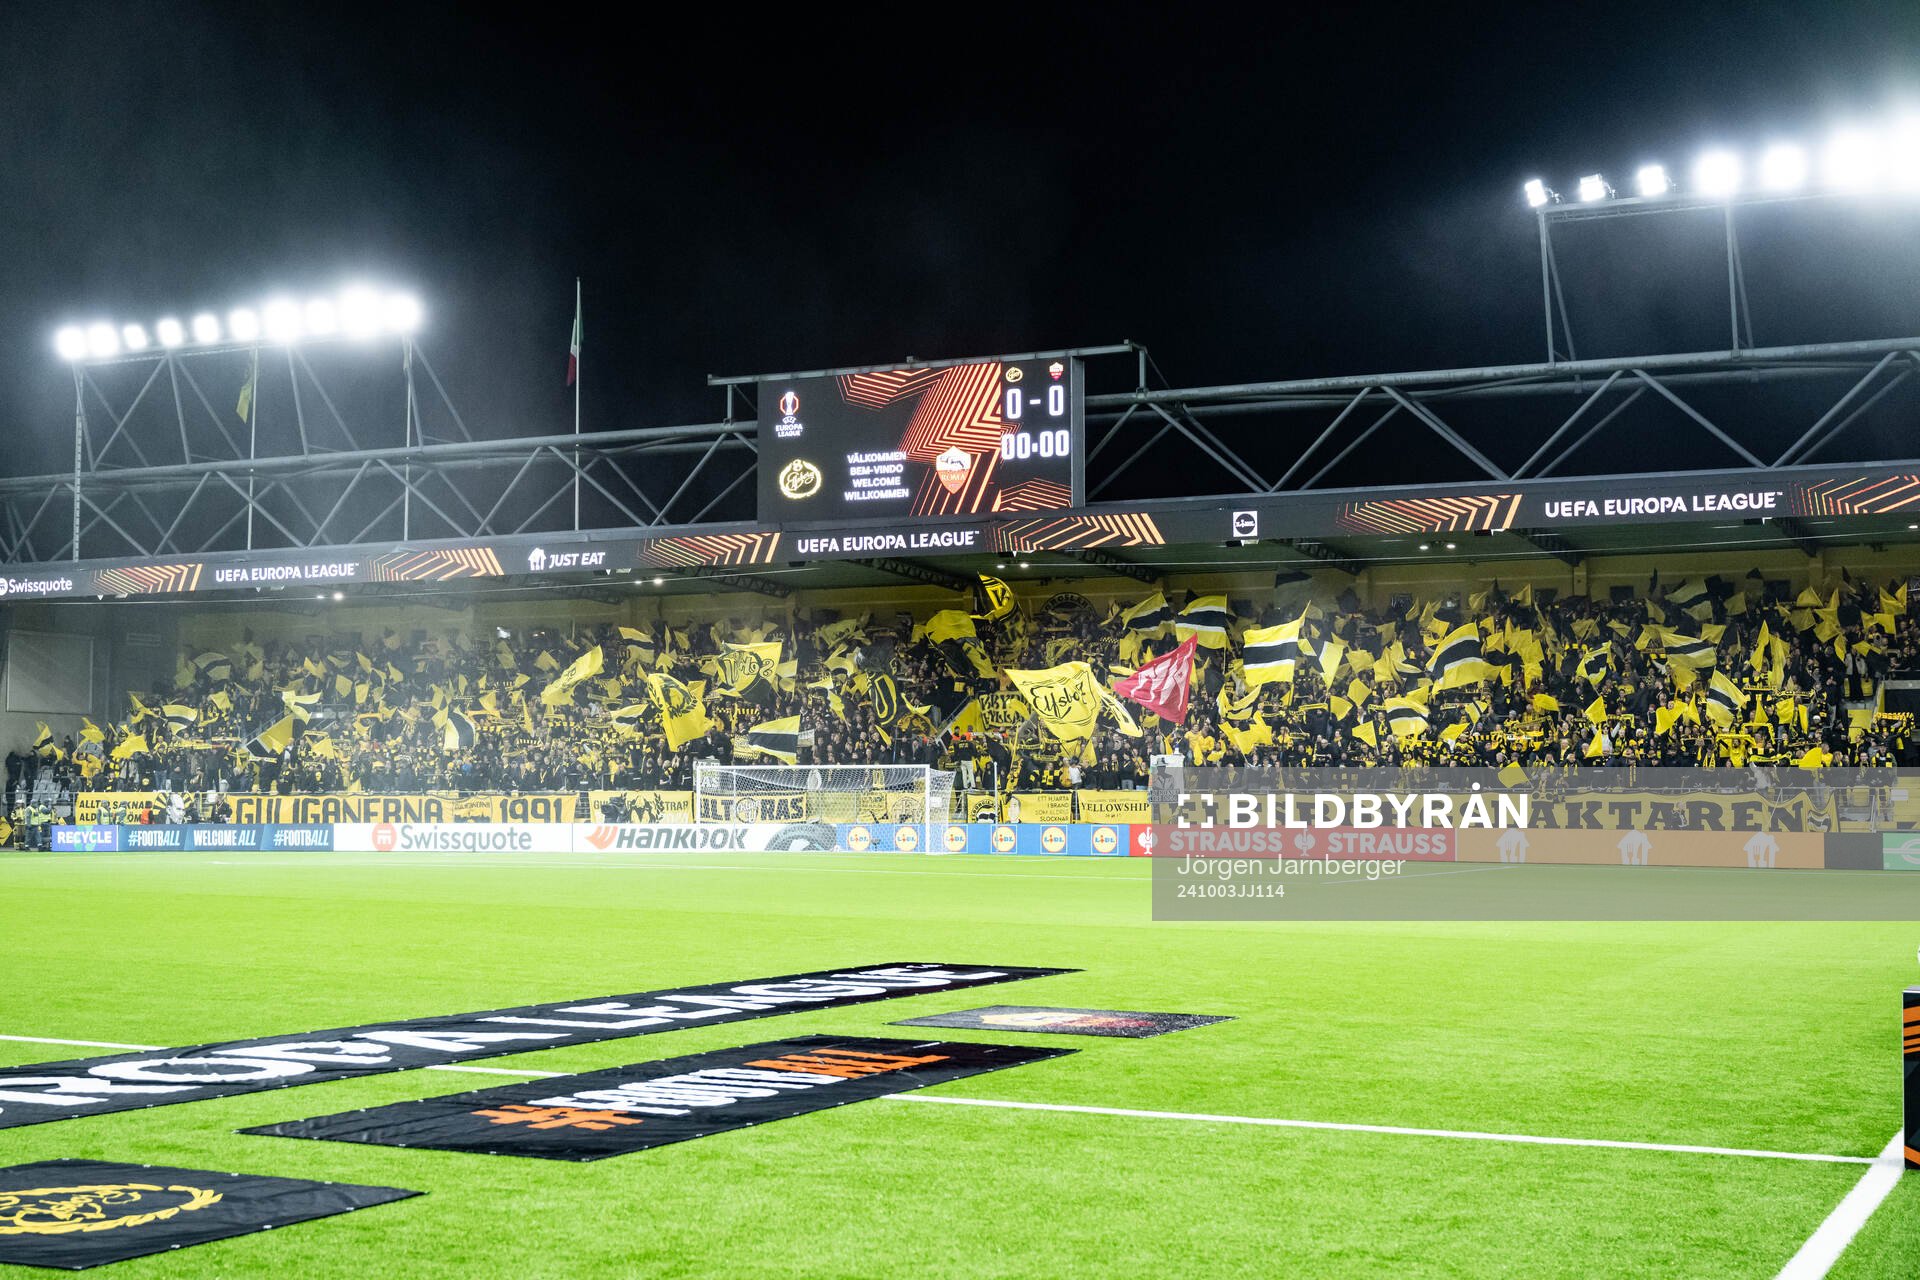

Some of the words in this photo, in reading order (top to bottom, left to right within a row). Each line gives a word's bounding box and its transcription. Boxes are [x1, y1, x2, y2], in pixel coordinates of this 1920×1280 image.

[1006, 388, 1022, 419] 0
[1048, 385, 1064, 416] 0
[775, 423, 803, 432] EUROPA
[777, 430, 801, 438] LEAGUE
[847, 451, 907, 464] VÄLKOMMEN
[850, 463, 904, 476] BEM-VINDO
[940, 473, 966, 481] ROMA
[852, 476, 902, 488] WELCOME
[844, 488, 909, 501] WILLKOMMEN
[1545, 500, 1600, 518] UEFA
[1604, 496, 1688, 515] EUROPA
[1692, 492, 1777, 512] LEAGUE
[797, 538, 840, 554] UEFA
[843, 534, 907, 551] EUROPA
[910, 530, 974, 548] LEAGUE
[548, 553, 579, 569] JUST
[581, 552, 605, 566] EAT
[215, 568, 249, 582] UEFA
[251, 566, 302, 580] EUROPA
[304, 562, 355, 579] LEAGUE
[8, 577, 73, 596] Swissquote
[499, 798, 563, 824] 1991
[1080, 802, 1150, 813] YELLOWSHIP
[57, 830, 112, 844] RECYCLE
[128, 829, 181, 847] #FOOTBALL
[194, 829, 237, 846] WELCOME
[237, 829, 257, 846] ALL
[273, 829, 329, 847] #FOOTBALL
[401, 825, 532, 852] Swissquote
[1169, 831, 1283, 853] STRAUSS
[1327, 832, 1447, 855] STRAUSS
